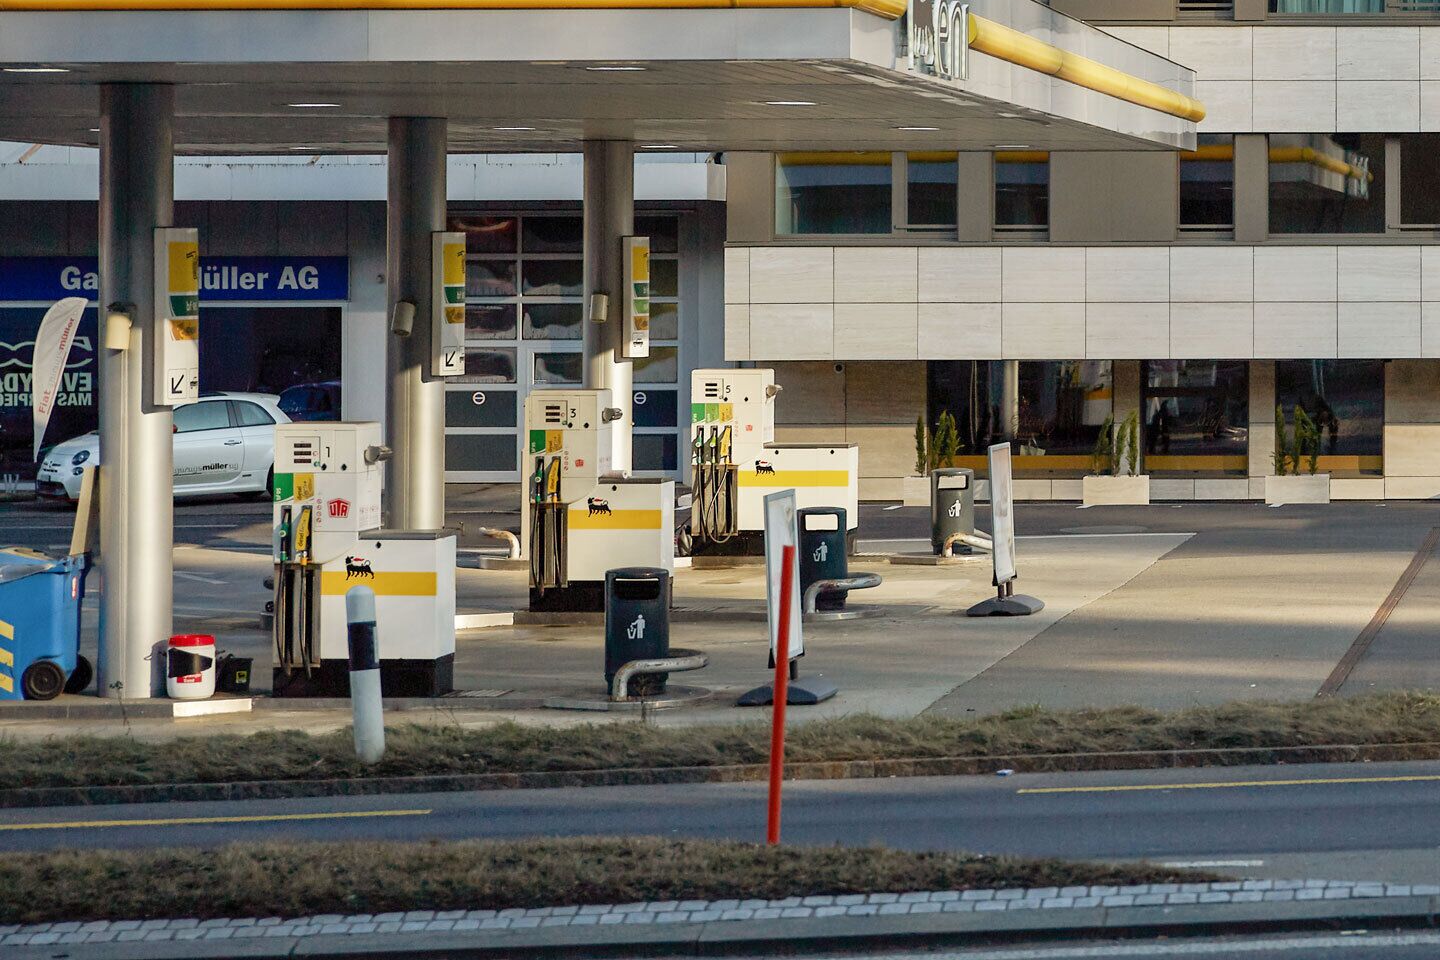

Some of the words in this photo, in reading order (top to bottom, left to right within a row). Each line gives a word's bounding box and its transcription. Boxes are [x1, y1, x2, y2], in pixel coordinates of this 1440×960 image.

[277, 265, 320, 290] AG
[725, 384, 731, 394] 5
[569, 408, 577, 419] 3
[325, 446, 331, 458] 1
